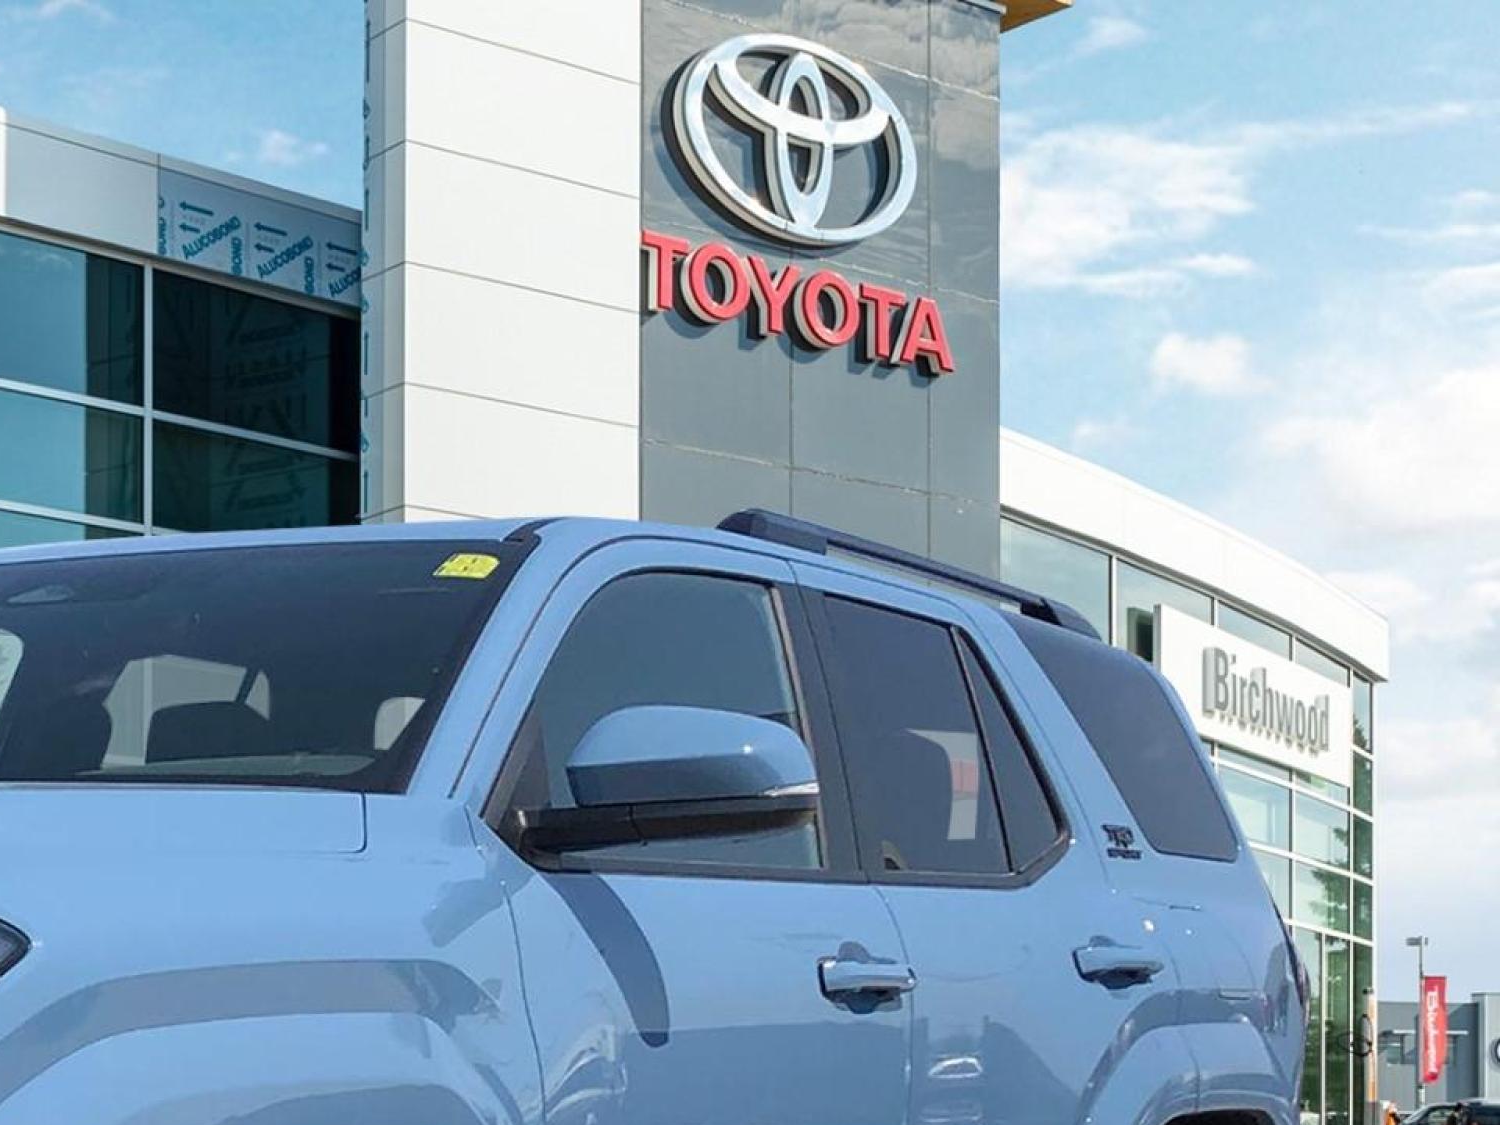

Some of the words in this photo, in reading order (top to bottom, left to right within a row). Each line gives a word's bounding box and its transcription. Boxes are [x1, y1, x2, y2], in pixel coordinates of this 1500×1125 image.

[181, 215, 241, 260] ALUCOBOND
[641, 229, 955, 375] TOYOTA
[1211, 646, 1329, 752] Birchwood
